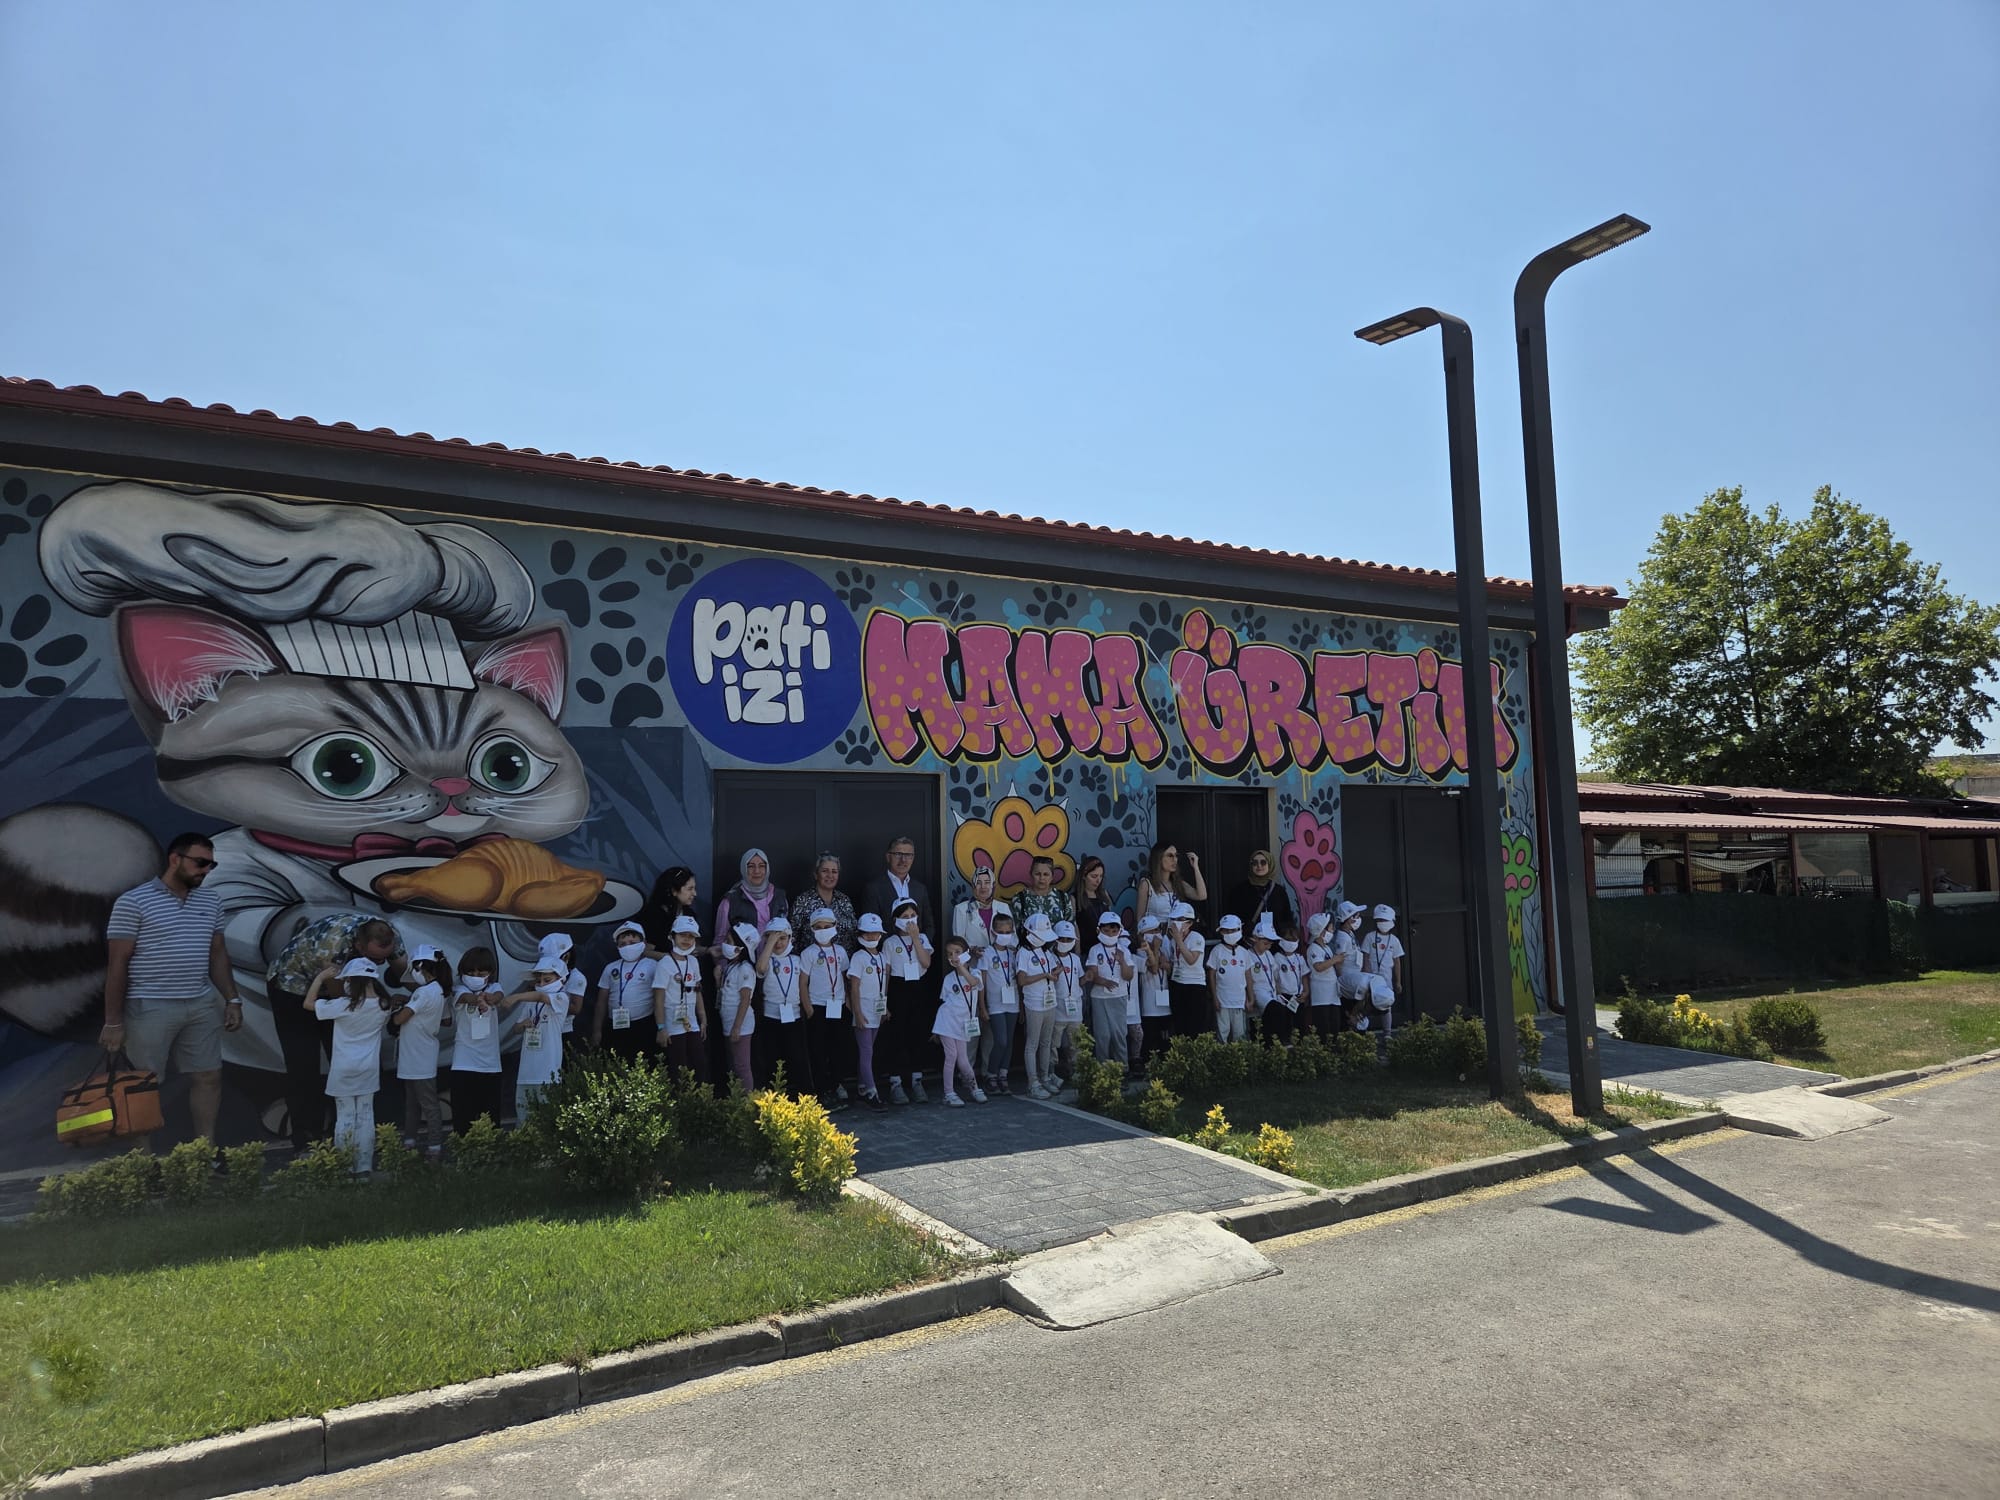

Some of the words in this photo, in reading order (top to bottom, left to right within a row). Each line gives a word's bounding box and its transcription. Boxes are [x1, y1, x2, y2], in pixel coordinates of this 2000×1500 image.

[692, 598, 832, 684] pati
[721, 663, 806, 725] izi
[866, 610, 1166, 763] MAMA
